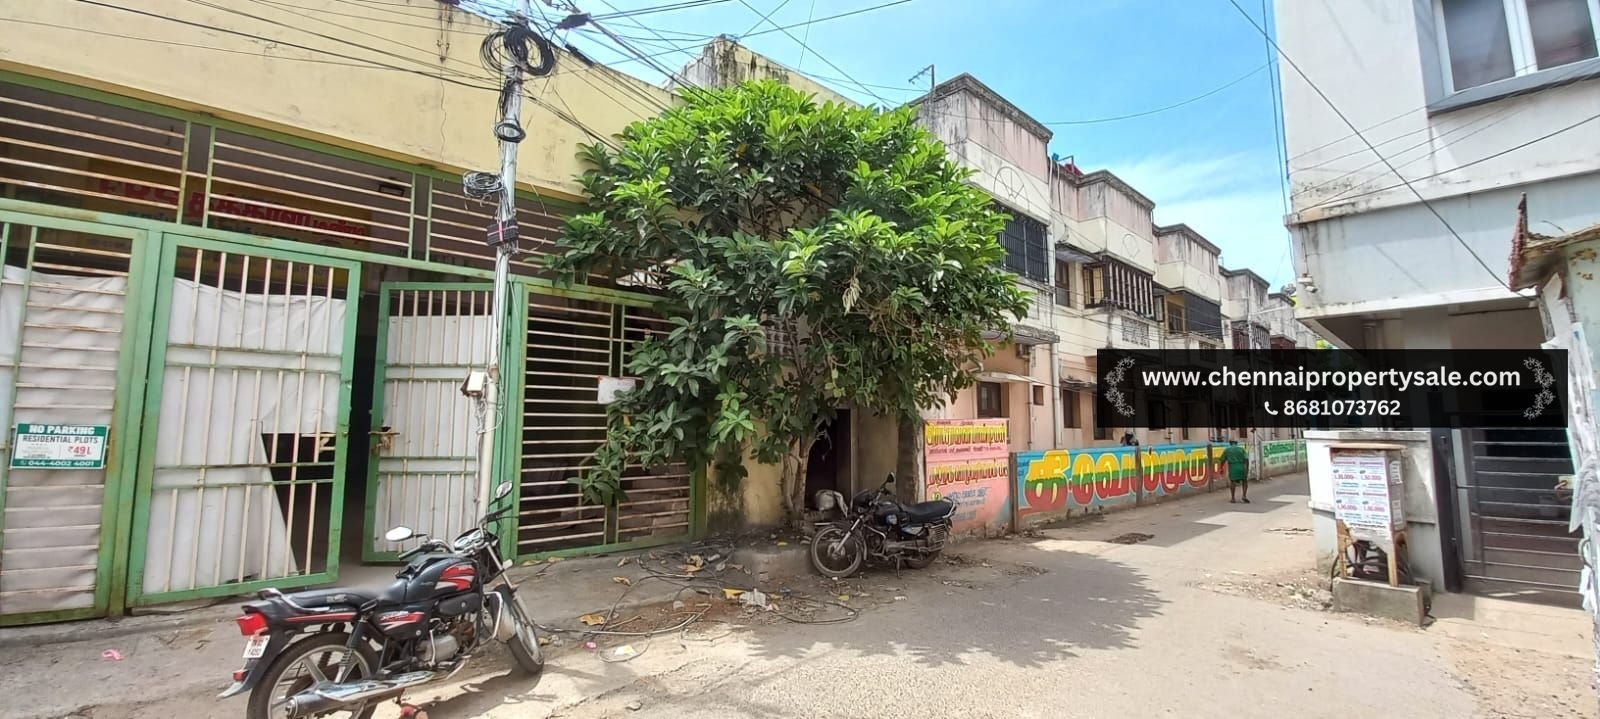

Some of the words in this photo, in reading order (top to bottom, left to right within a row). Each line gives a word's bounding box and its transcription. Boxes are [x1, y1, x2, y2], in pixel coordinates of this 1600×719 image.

[28, 425, 45, 434] NO
[46, 426, 95, 435] PARKING
[23, 435, 72, 443] RESIDENTIAL
[75, 436, 98, 444] PLOTS
